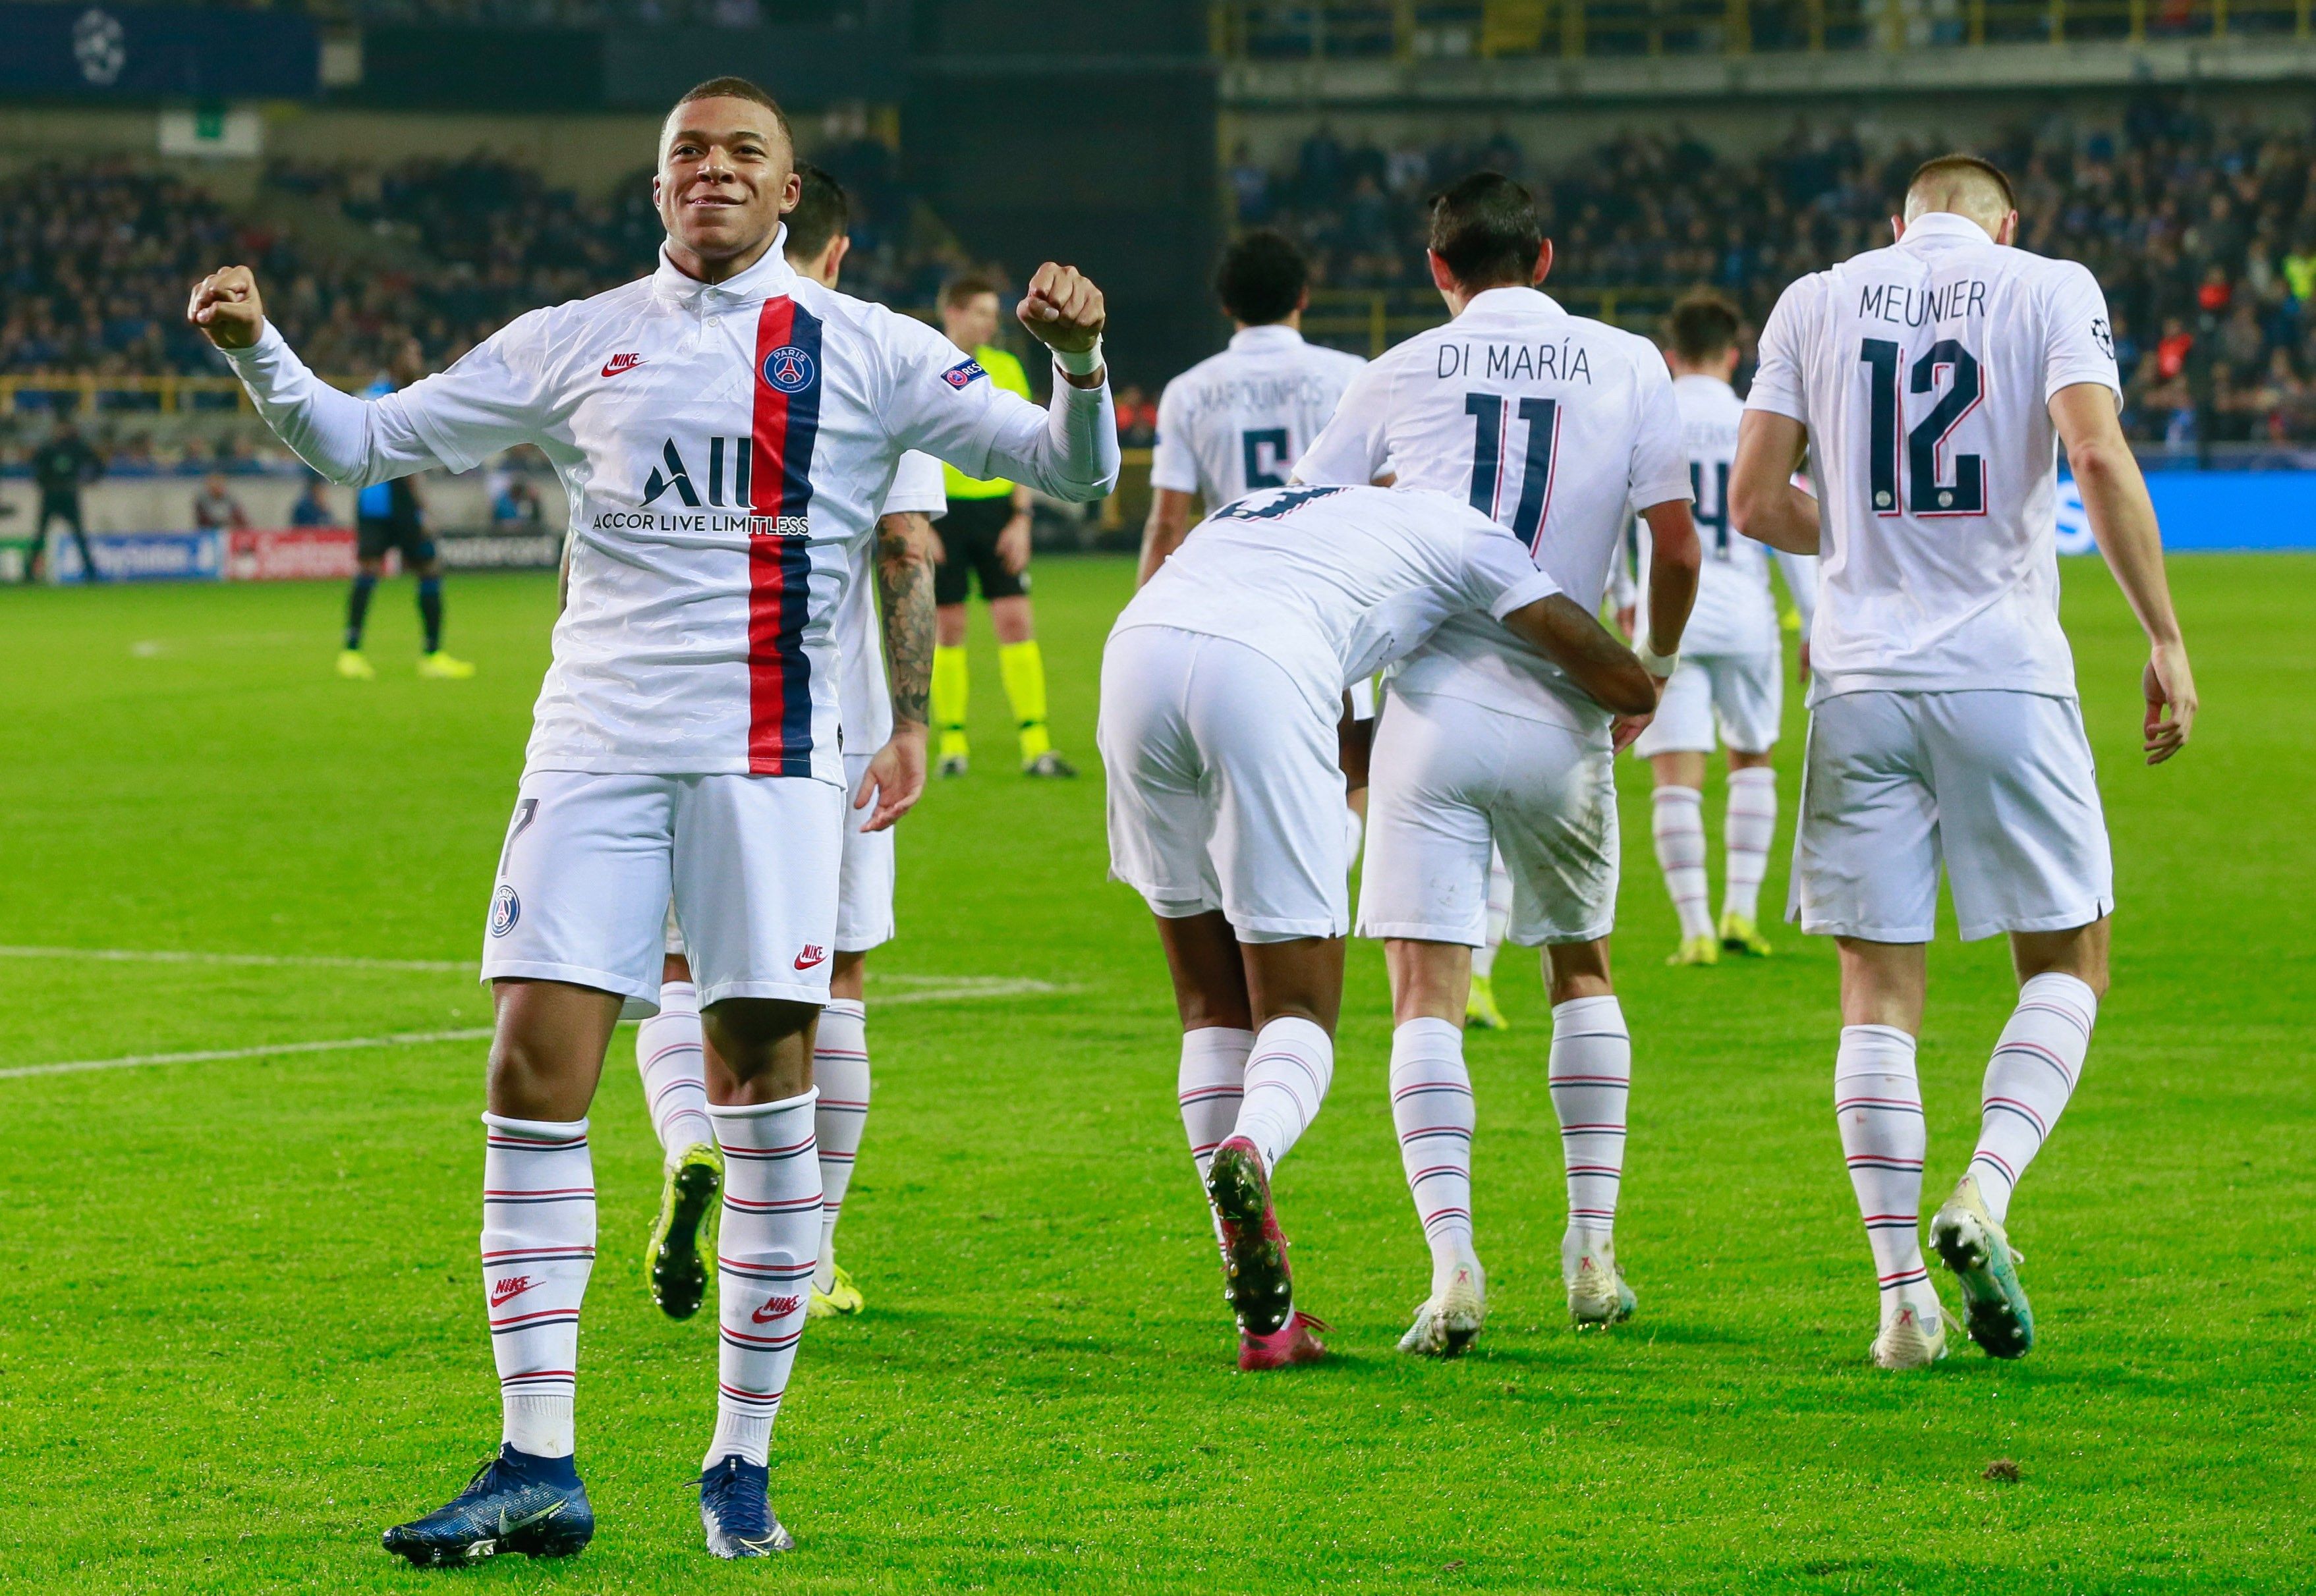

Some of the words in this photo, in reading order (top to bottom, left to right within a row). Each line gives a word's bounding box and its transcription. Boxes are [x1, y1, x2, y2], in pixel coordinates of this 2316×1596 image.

[1859, 279, 1987, 327] MEUNIER
[609, 352, 640, 367] NIKE
[773, 349, 806, 362] PARIS
[1438, 343, 1469, 379] DI
[1486, 337, 1591, 385] MARÍA
[1860, 338, 1987, 517] 12
[1243, 428, 1291, 489] 5
[1465, 393, 1561, 559] 11
[593, 513, 654, 530] ACCOR
[661, 515, 706, 532] LIVE
[712, 515, 809, 534] LIMITLESS
[501, 798, 540, 879] 7
[801, 944, 823, 960] NIKE
[495, 1275, 530, 1294] NIKE
[763, 1294, 799, 1312] NIKE
